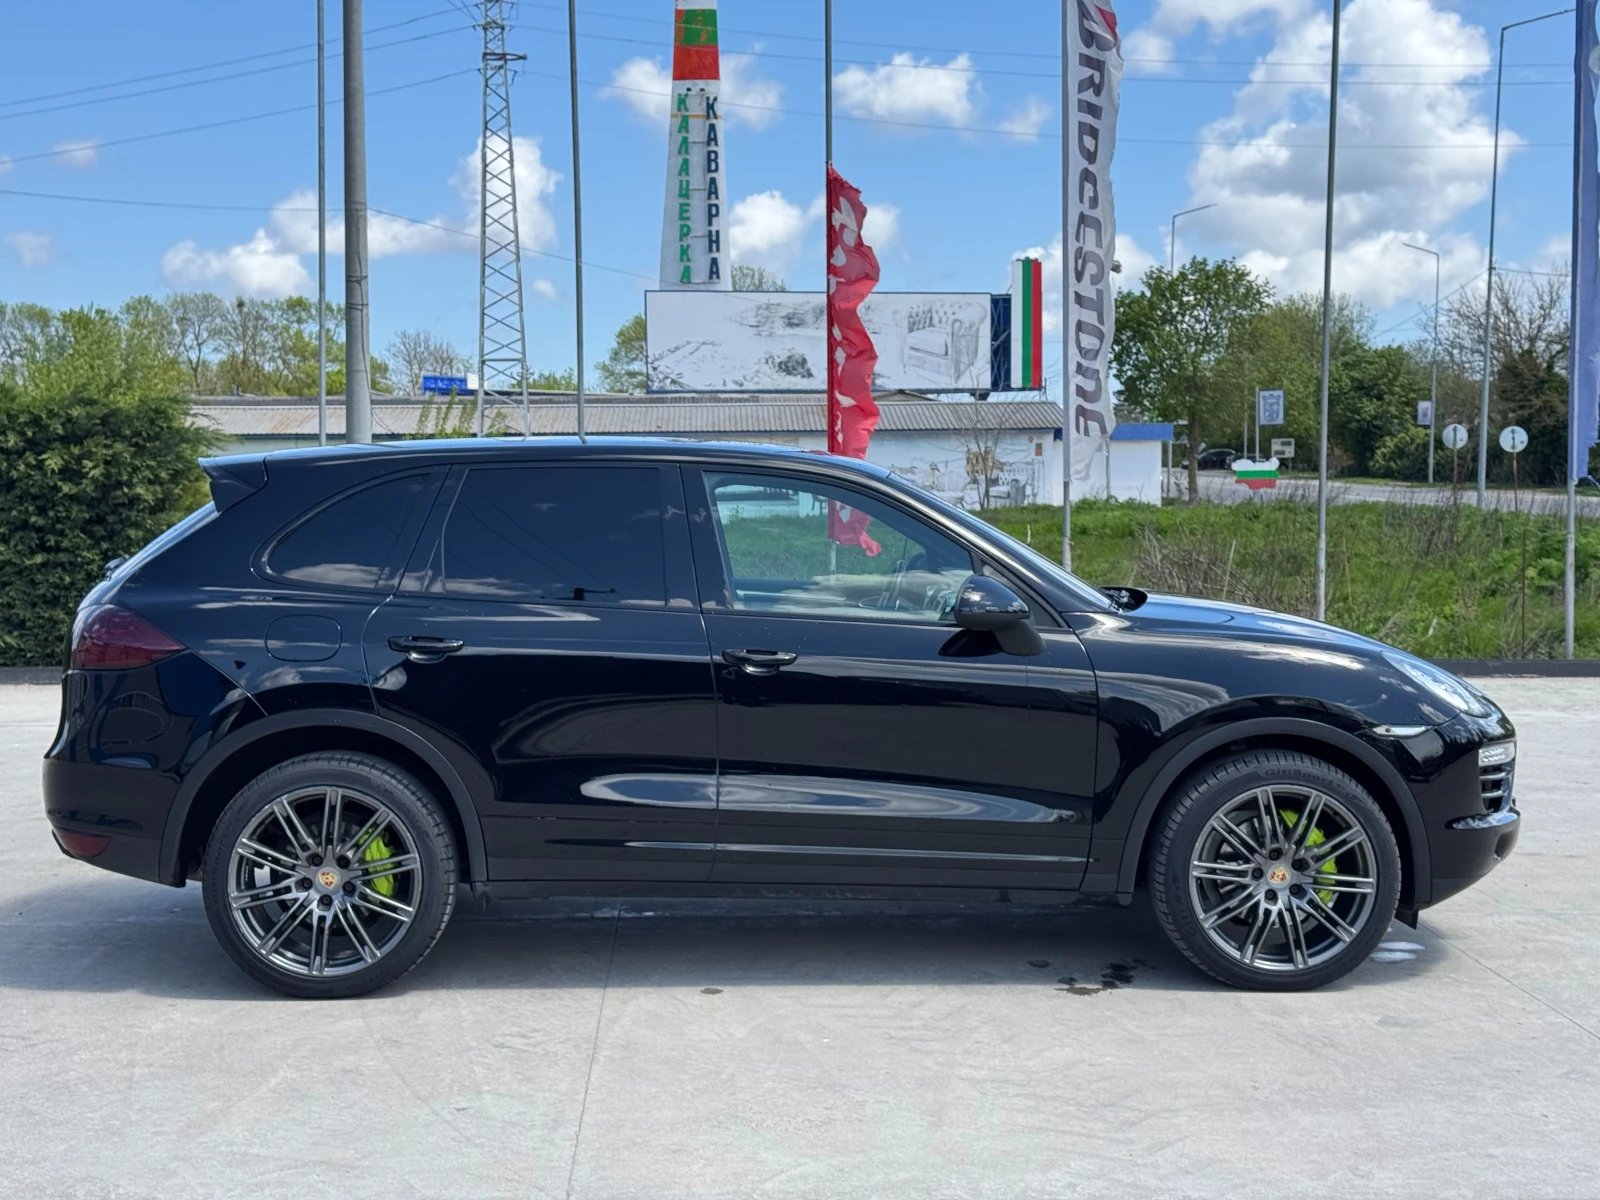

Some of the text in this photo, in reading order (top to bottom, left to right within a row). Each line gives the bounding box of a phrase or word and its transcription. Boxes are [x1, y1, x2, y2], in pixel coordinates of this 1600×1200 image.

[676, 93, 692, 284] КАЛАЦЕРКА
[705, 96, 721, 281] КАВАРНА
[1074, 0, 1117, 437] BRIDGESTONE
[1264, 768, 1334, 787] GitiSport
